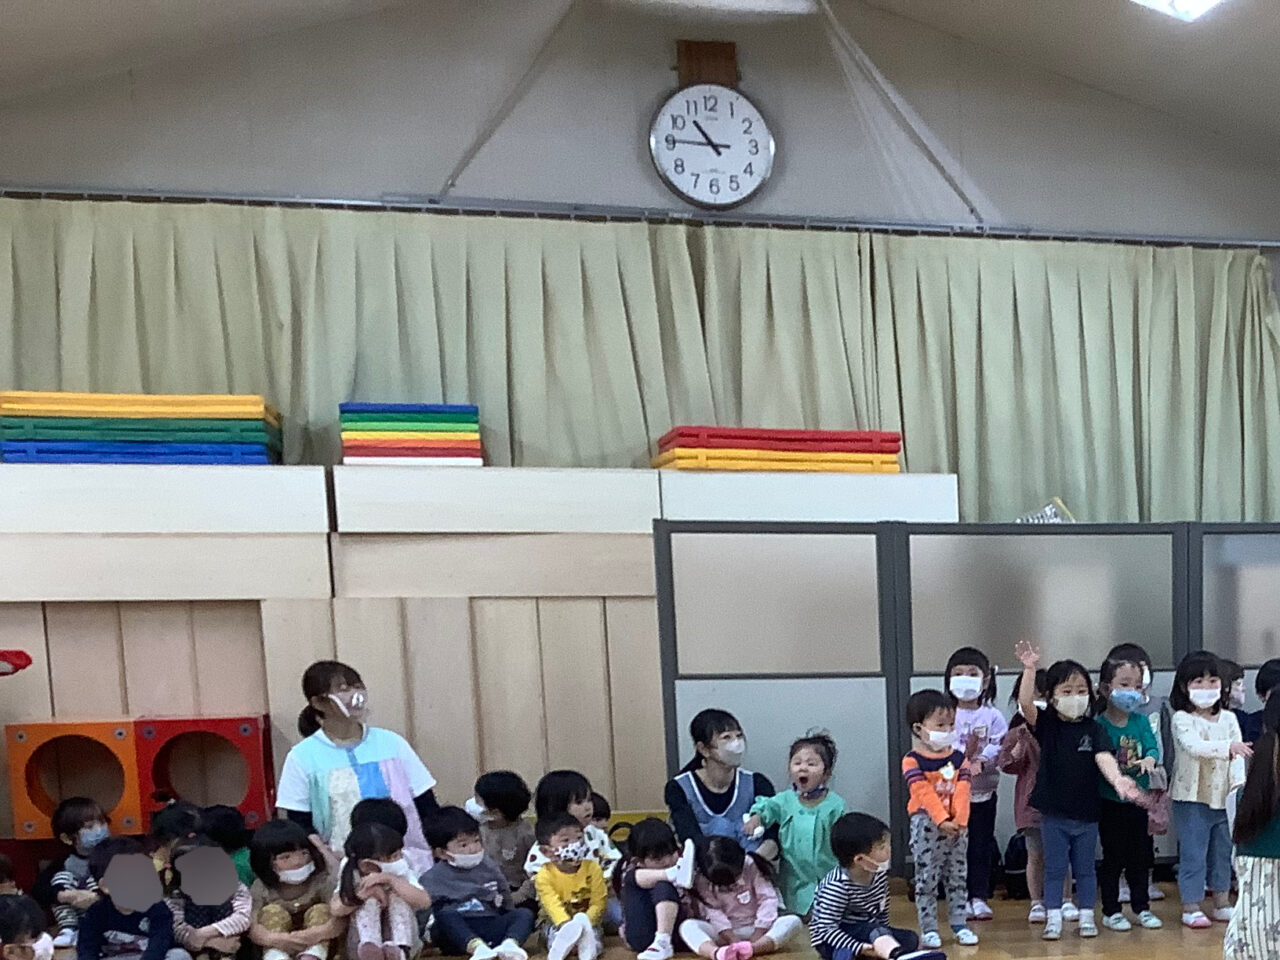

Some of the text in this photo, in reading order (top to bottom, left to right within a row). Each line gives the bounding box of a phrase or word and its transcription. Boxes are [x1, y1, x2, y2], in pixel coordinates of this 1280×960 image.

[685, 100, 698, 116] 11
[703, 95, 718, 112] 12
[730, 101, 734, 118] 1
[670, 114, 686, 130] 10
[742, 118, 753, 135] 2
[665, 134, 676, 151] 9
[748, 139, 759, 155] 3
[674, 158, 685, 174] 8
[743, 162, 754, 177] 4
[691, 173, 700, 189] 7
[709, 178, 720, 195] 6
[729, 175, 740, 191] 5
